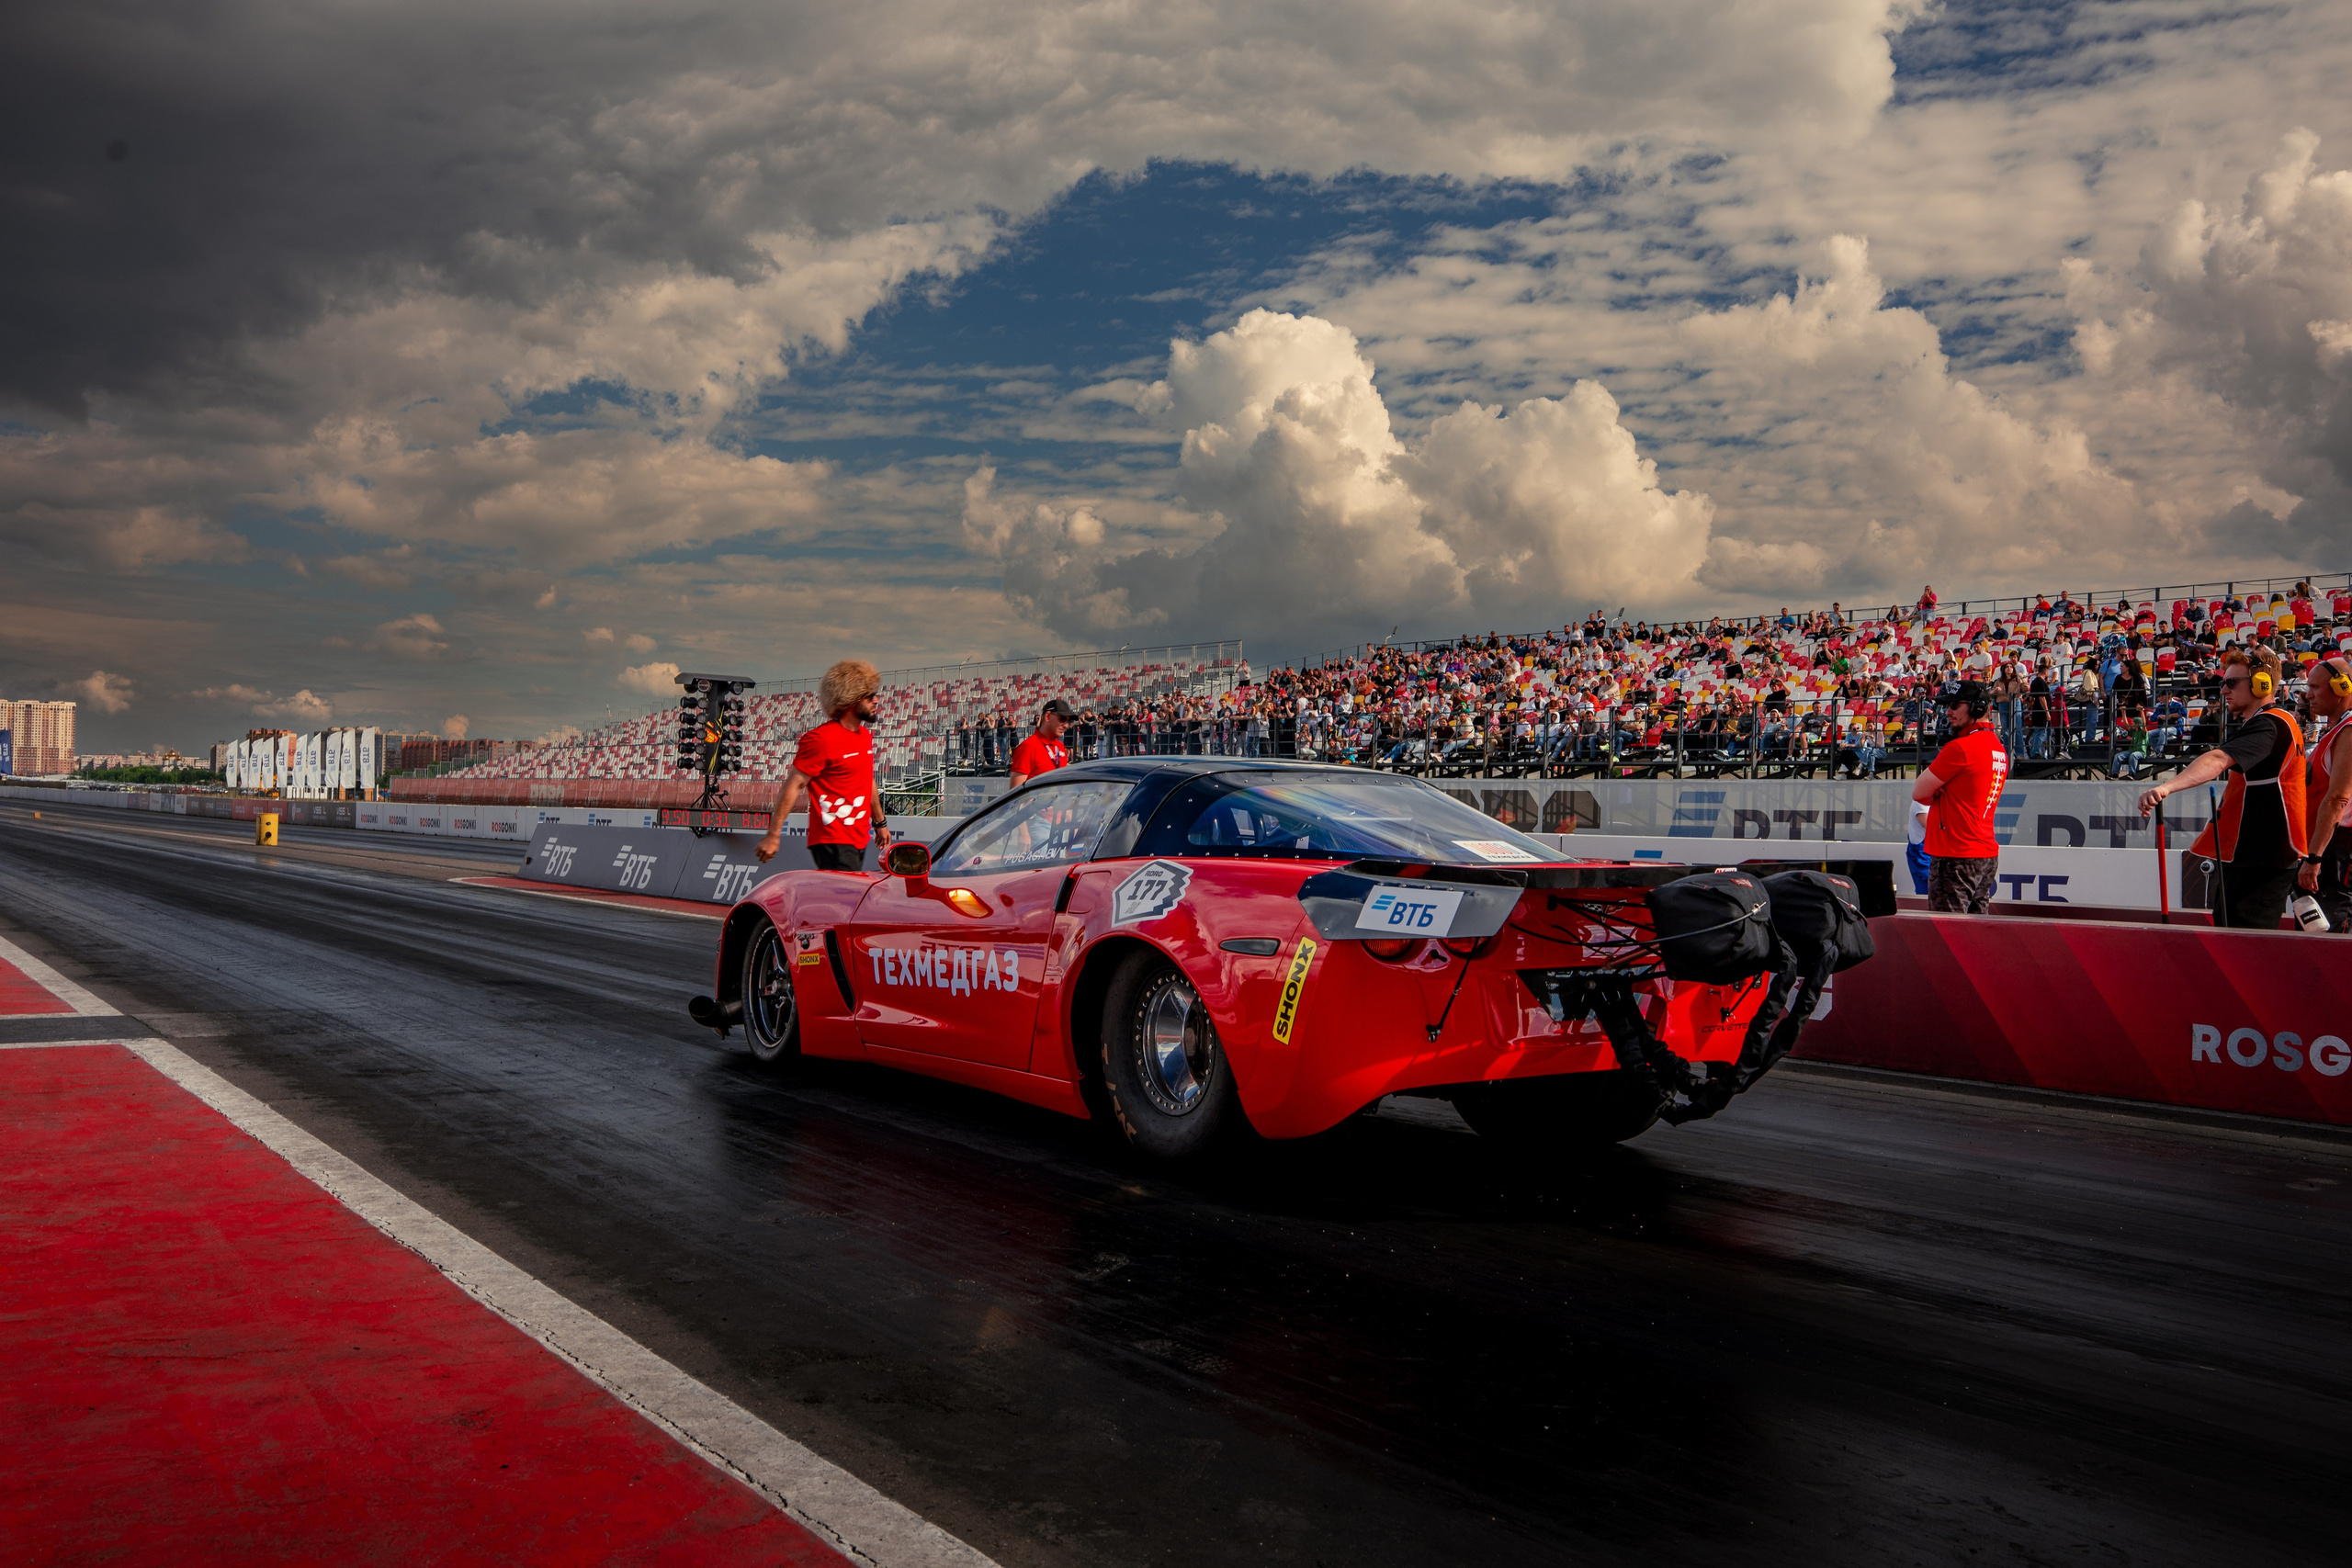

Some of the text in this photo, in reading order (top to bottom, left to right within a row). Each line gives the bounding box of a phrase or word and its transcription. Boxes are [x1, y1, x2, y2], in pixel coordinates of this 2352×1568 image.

[361, 814, 378, 823] ROSGONKI
[389, 816, 407, 826] ROSGONKI
[420, 818, 440, 828] ROSGONKI
[455, 819, 476, 829] ROSGONKI
[702, 810, 729, 827] 0:31
[491, 822, 517, 833] ROSGONKI
[545, 845, 578, 877] ВТБ
[1005, 847, 1061, 864] PUGACHEV
[618, 853, 658, 889] ВТБ
[712, 863, 759, 902] ВТБ
[1127, 879, 1169, 900] 177
[1388, 901, 1438, 928] ВТБ
[799, 955, 820, 964] SHONX
[868, 948, 1019, 998] ТЕХМЕДГАЗ
[1276, 942, 1314, 1038] SHONX
[1702, 1022, 1748, 1033] CORVETTE
[2191, 1023, 2352, 1077] ROSG
